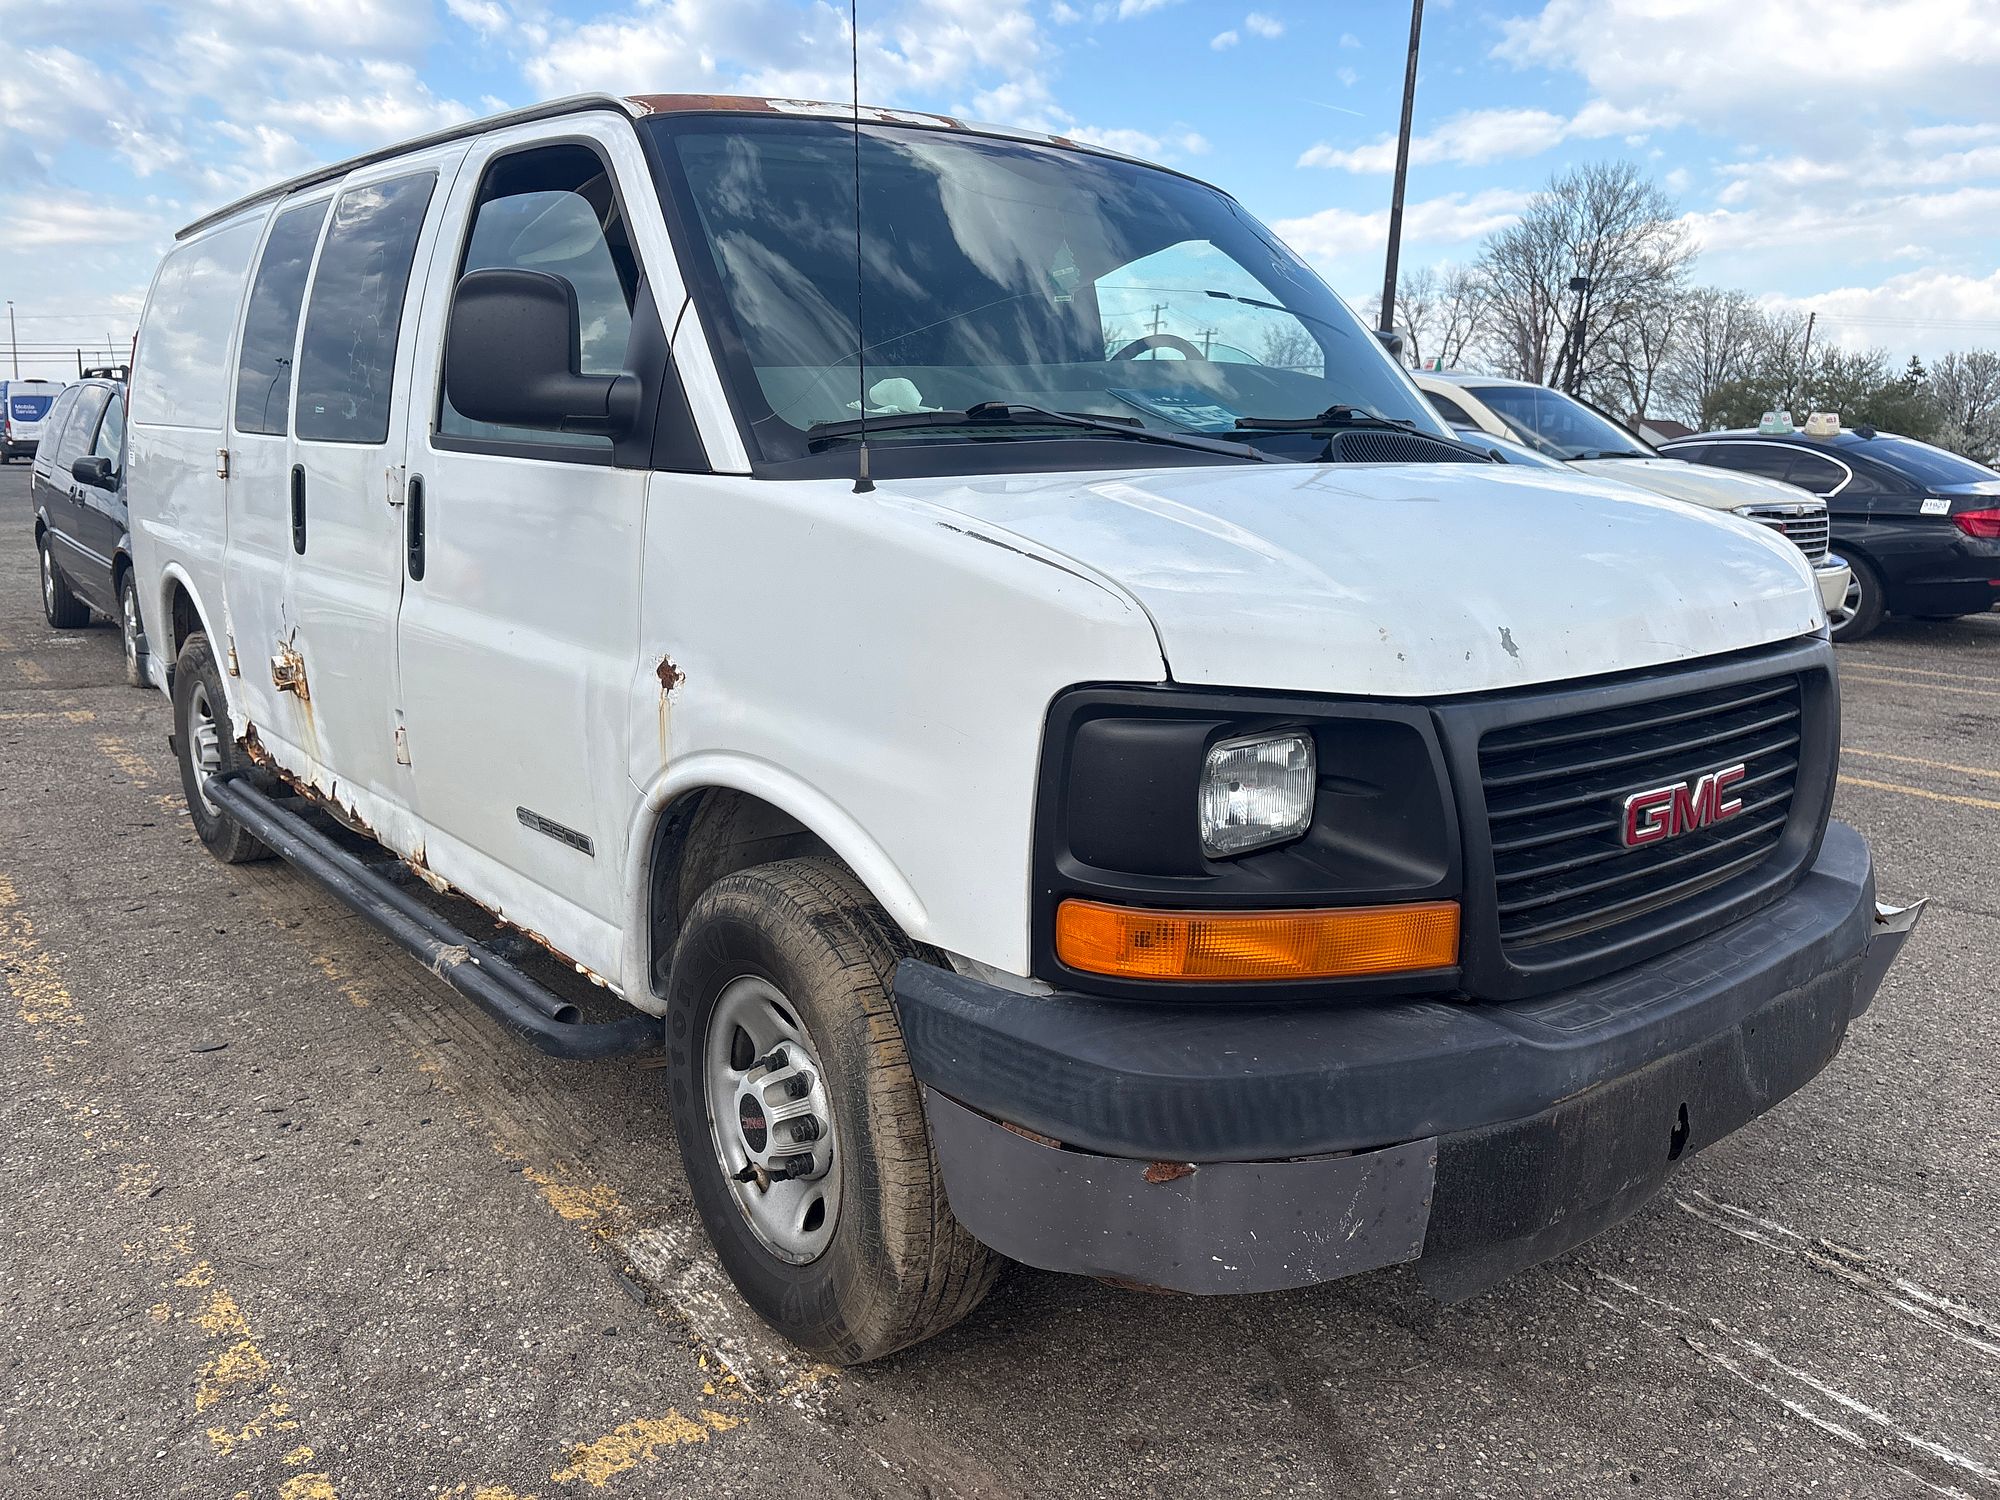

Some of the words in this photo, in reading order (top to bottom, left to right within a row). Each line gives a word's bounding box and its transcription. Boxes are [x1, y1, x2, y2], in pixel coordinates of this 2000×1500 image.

[1622, 763, 1745, 848] GMC
[539, 817, 592, 855] 2500
[742, 1116, 766, 1129] GMC
